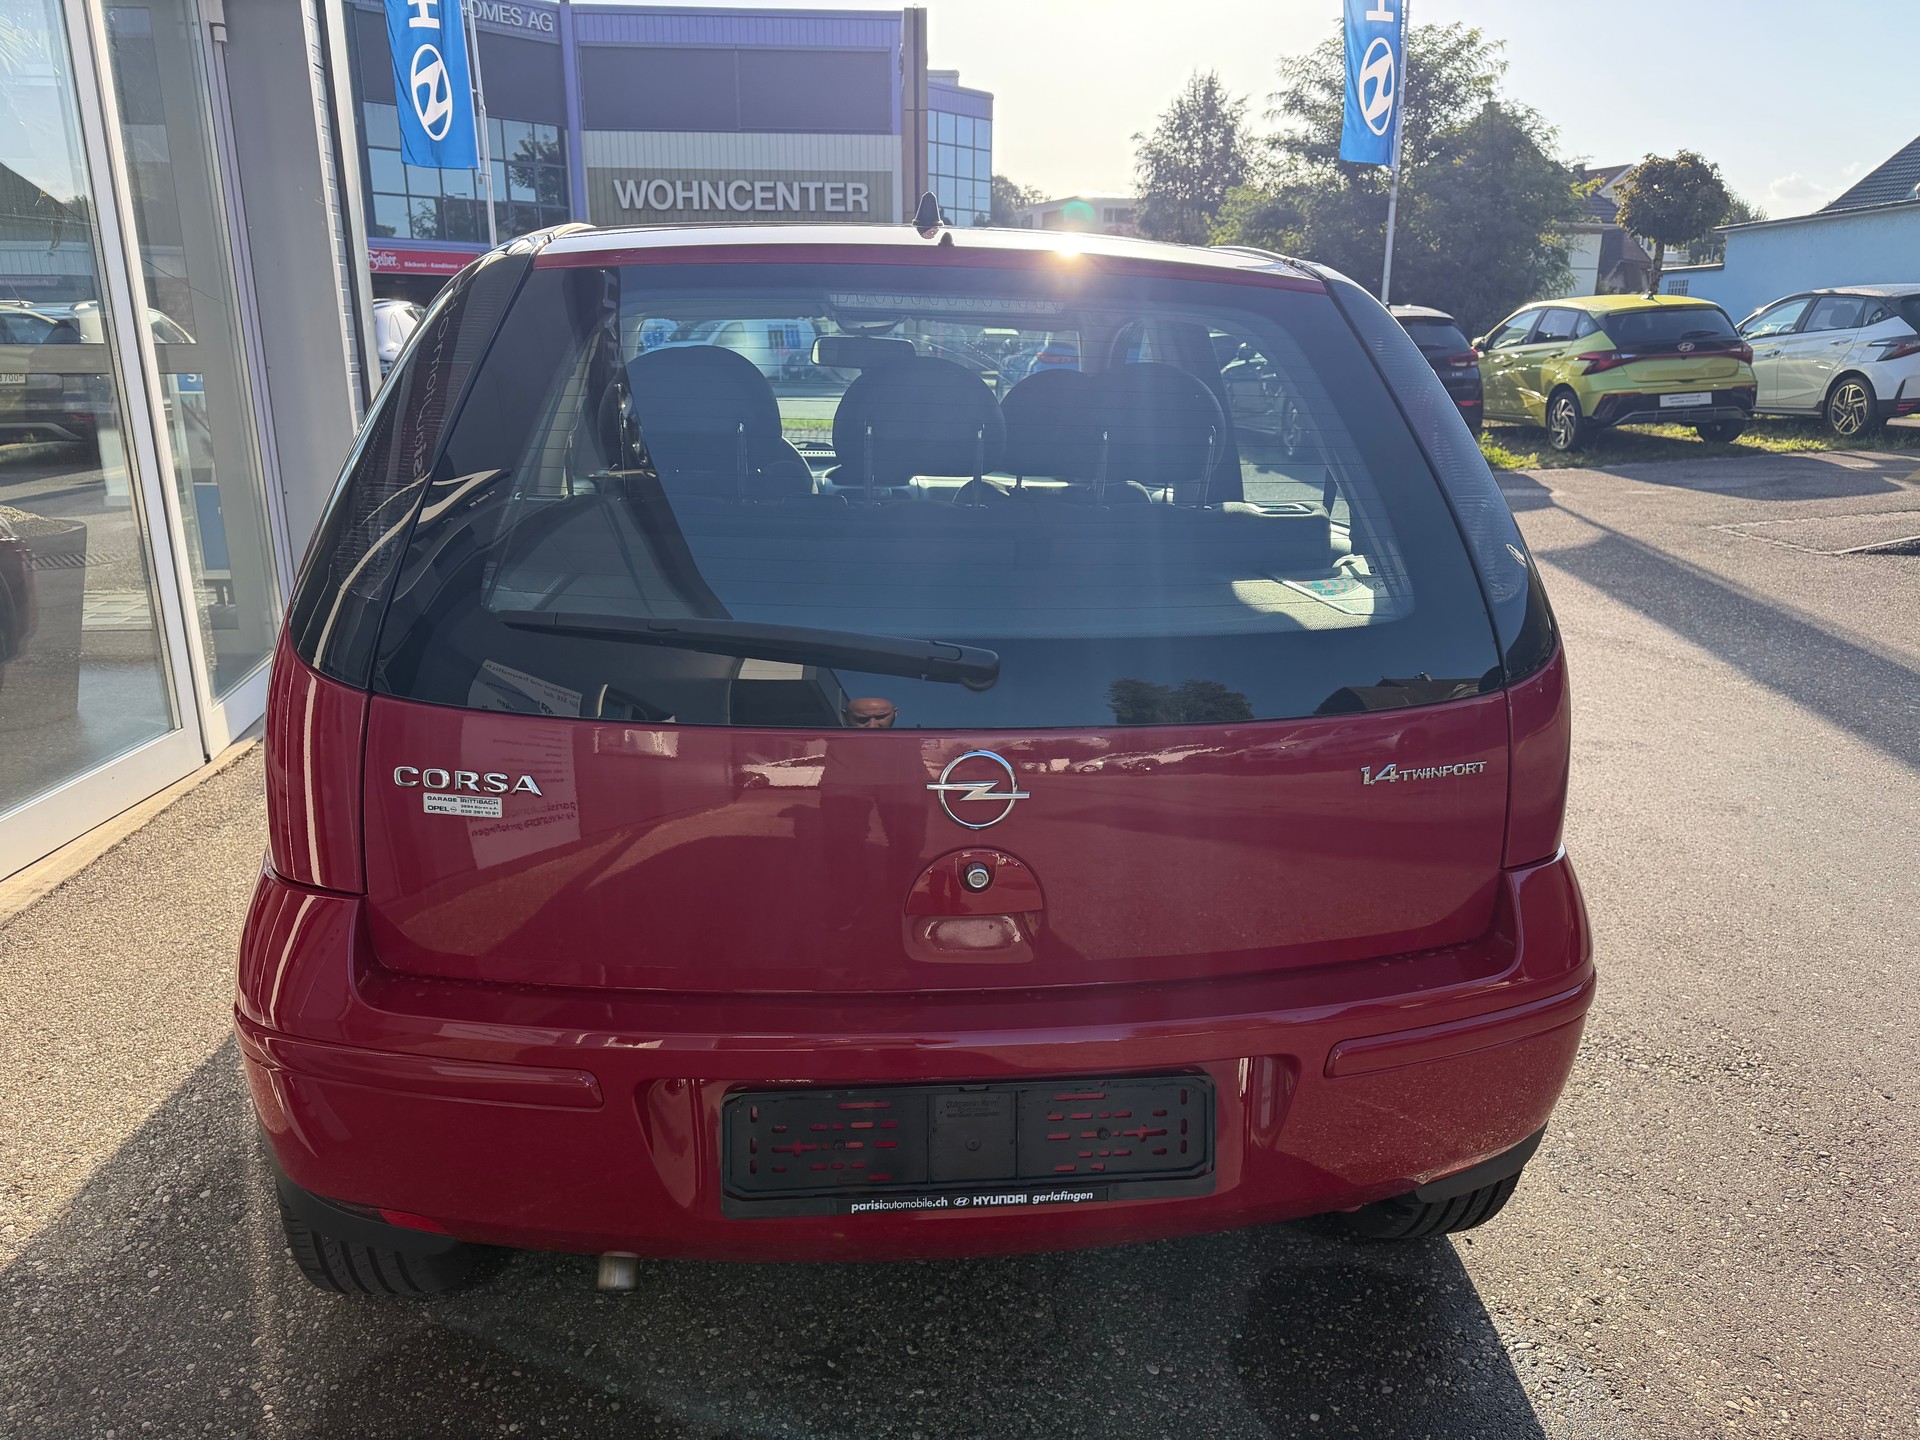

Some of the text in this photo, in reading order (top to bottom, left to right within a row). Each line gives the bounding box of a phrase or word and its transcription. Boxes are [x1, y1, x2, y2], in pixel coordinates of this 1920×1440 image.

[527, 11, 554, 33] AG
[613, 178, 870, 213] WOHNCENTER
[393, 766, 543, 797] CORSA
[1361, 761, 1487, 785] 1.4 TWINPORT
[427, 795, 457, 803] GARAGE
[850, 1189, 1094, 1215] parisiautomobile.ch HYUNDAI gerlafingen
